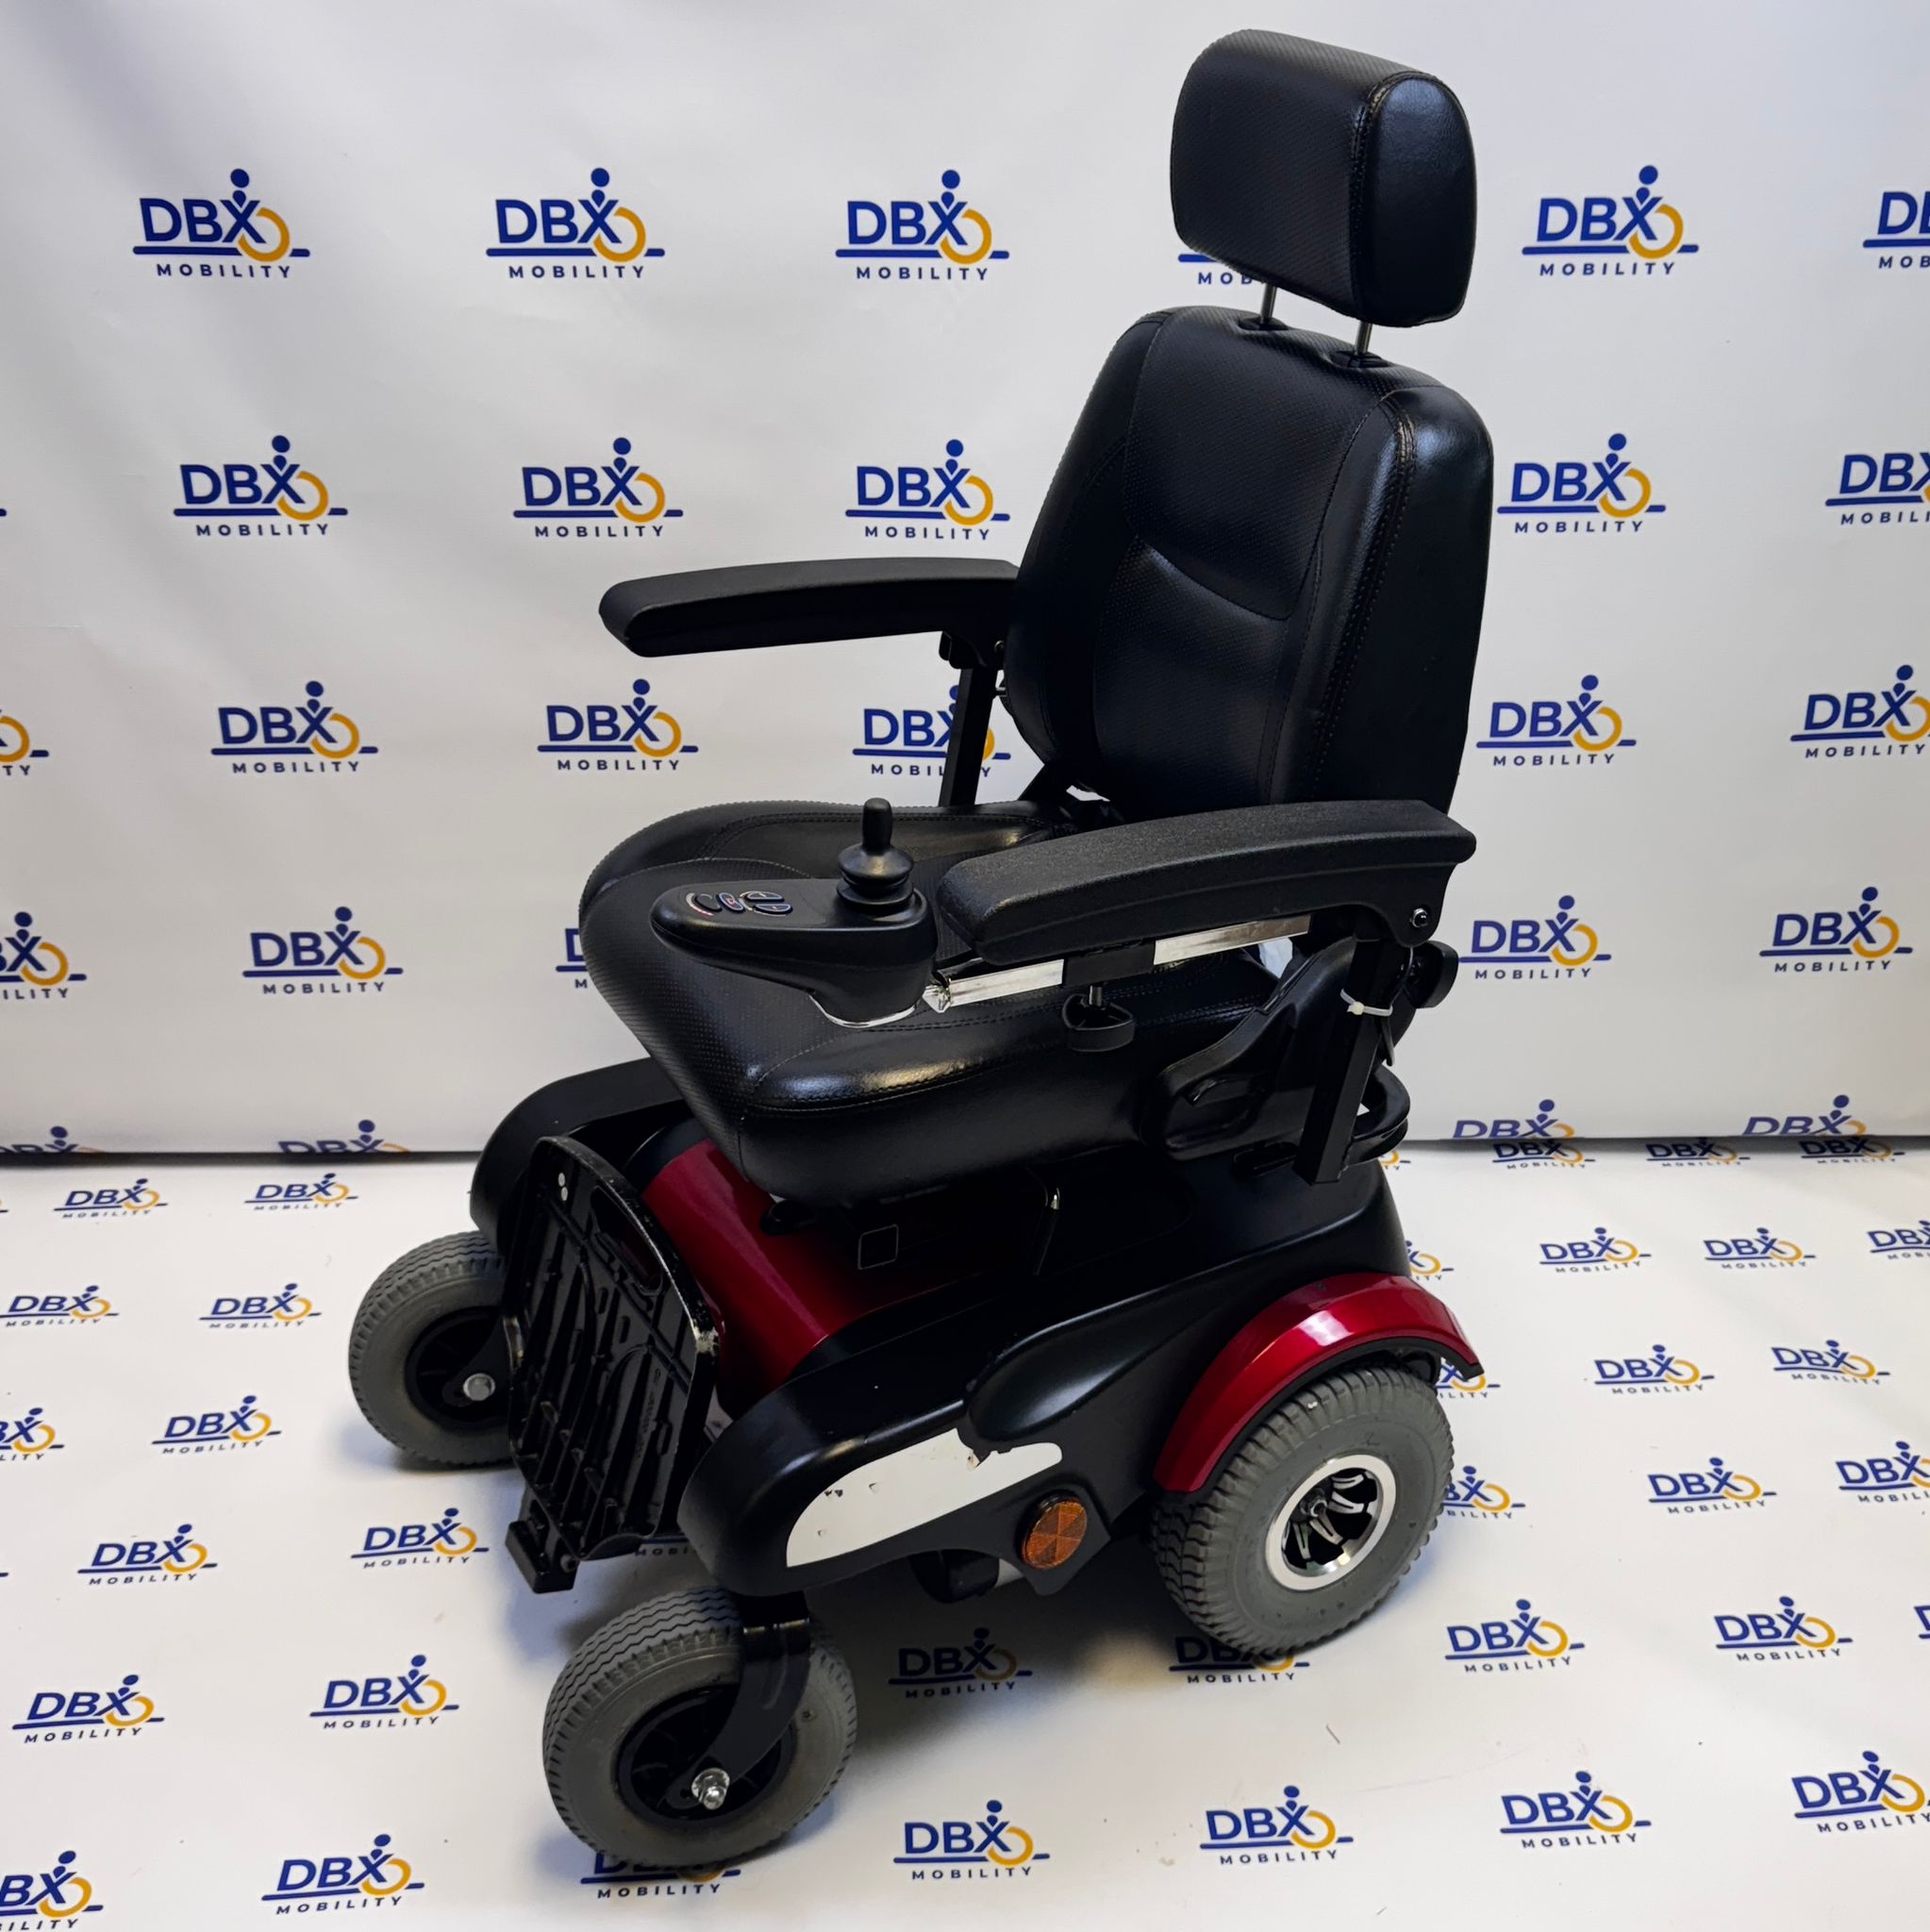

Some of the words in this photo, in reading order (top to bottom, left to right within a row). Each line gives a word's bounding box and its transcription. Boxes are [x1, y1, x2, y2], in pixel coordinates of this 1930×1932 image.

[140, 198, 266, 243] DBX
[496, 199, 622, 243] DBX
[848, 201, 968, 245] DBX
[1537, 197, 1662, 242] DBX
[157, 264, 290, 277] MOBILITY
[509, 266, 643, 278] MOBILITY
[857, 267, 987, 280] MOBILITY
[1539, 262, 1674, 275] MOBILITY
[180, 464, 305, 505] DBX
[523, 466, 641, 506] DBX
[857, 466, 970, 508] DBX
[1511, 462, 1630, 502] DBX
[196, 524, 327, 536] MOBILITY
[535, 525, 662, 537] MOBILITY
[865, 526, 989, 540] MOBILITY
[1515, 521, 1642, 533] MOBILITY
[1489, 701, 1603, 738] DBX
[1805, 691, 1916, 730] DBX
[218, 707, 337, 744] DBX
[547, 706, 659, 741] DBX
[1493, 754, 1614, 766] MOBILITY
[1805, 744, 1925, 758] MOBILITY
[233, 761, 358, 774] MOBILITY
[557, 759, 678, 770] MOBILITY
[1472, 919, 1578, 953] DBX
[1772, 910, 1881, 946] DBX
[250, 931, 363, 967] DBX
[1475, 968, 1590, 979] MOBILITY
[1774, 960, 1890, 972] MOBILITY
[263, 982, 384, 994] MOBILITY
[1453, 1119, 1557, 1139] DBX
[1743, 1116, 1851, 1136] DBX
[1493, 1141, 1569, 1158] DBX
[1645, 1141, 1722, 1158] DBX
[1799, 1136, 1875, 1155] DBX
[65, 1188, 146, 1207] DBX
[256, 1180, 336, 1199] DBX
[1540, 1238, 1622, 1259] DBX
[1704, 1235, 1786, 1256] DBX
[1556, 1261, 1639, 1272] MOBILITY
[8, 1294, 98, 1312] DBX
[211, 1296, 297, 1315] DBX
[6, 1319, 99, 1327] MOBILITY
[1594, 1355, 1682, 1379] DBX
[1772, 1345, 1858, 1370] DBX
[1791, 1372, 1886, 1385] MOBILITY
[1612, 1385, 1703, 1393] MOBILITY
[164, 1409, 257, 1438] DBX
[163, 1442, 262, 1454] MOBILITY
[1836, 1456, 1930, 1484] DBX
[1648, 1472, 1742, 1496] DBX
[1668, 1501, 1764, 1513] MOBILITY
[363, 1523, 460, 1551] DBX
[92, 1540, 192, 1566] DBX
[364, 1557, 469, 1568] MOBILITY
[89, 1574, 196, 1585] MOBILITY
[1447, 1617, 1548, 1652] DBX
[1714, 1613, 1816, 1641] DBX
[897, 1644, 996, 1679] DBX
[1737, 1648, 1839, 1660] MOBILITY
[1465, 1657, 1570, 1672] MOBILITY
[1186, 1672, 1295, 1685] MOBILITY
[324, 1674, 428, 1708] DBX
[905, 1682, 1016, 1698] MOBILITY
[27, 1692, 139, 1720] DBX
[324, 1717, 438, 1728] MOBILITY
[25, 1727, 141, 1743] MOBILITY
[1792, 1770, 1905, 1808] DBX
[1502, 1790, 1612, 1824] DBX
[1206, 1806, 1314, 1840] DBX
[1818, 1813, 1930, 1832] MOBILITY
[905, 1822, 1011, 1854] DBX
[1522, 1833, 1636, 1848] MOBILITY
[1220, 1850, 1336, 1864] MOBILITY
[276, 1855, 389, 1892] DBX
[912, 1867, 1030, 1880] MOBILITY
[597, 1884, 720, 1898] MOBILITY
[276, 1896, 401, 1914] MOBILITY
